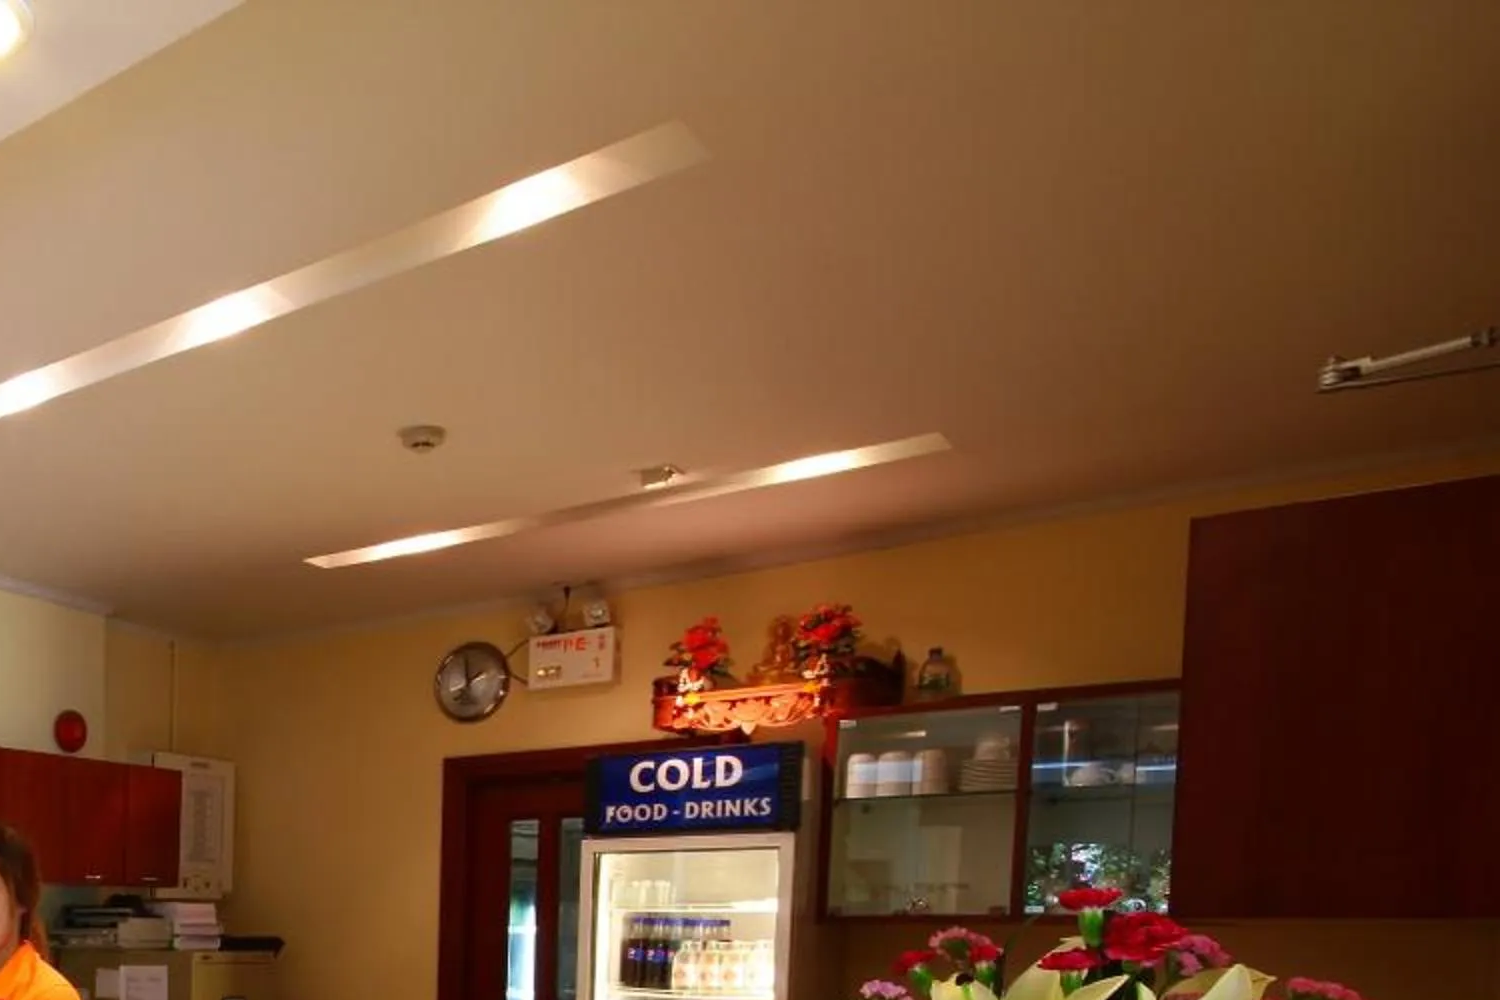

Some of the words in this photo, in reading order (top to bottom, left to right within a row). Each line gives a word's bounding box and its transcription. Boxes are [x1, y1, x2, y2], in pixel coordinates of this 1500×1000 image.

[629, 755, 743, 793] COLD
[605, 803, 668, 823] FOOD
[684, 797, 772, 819] DRINKS
